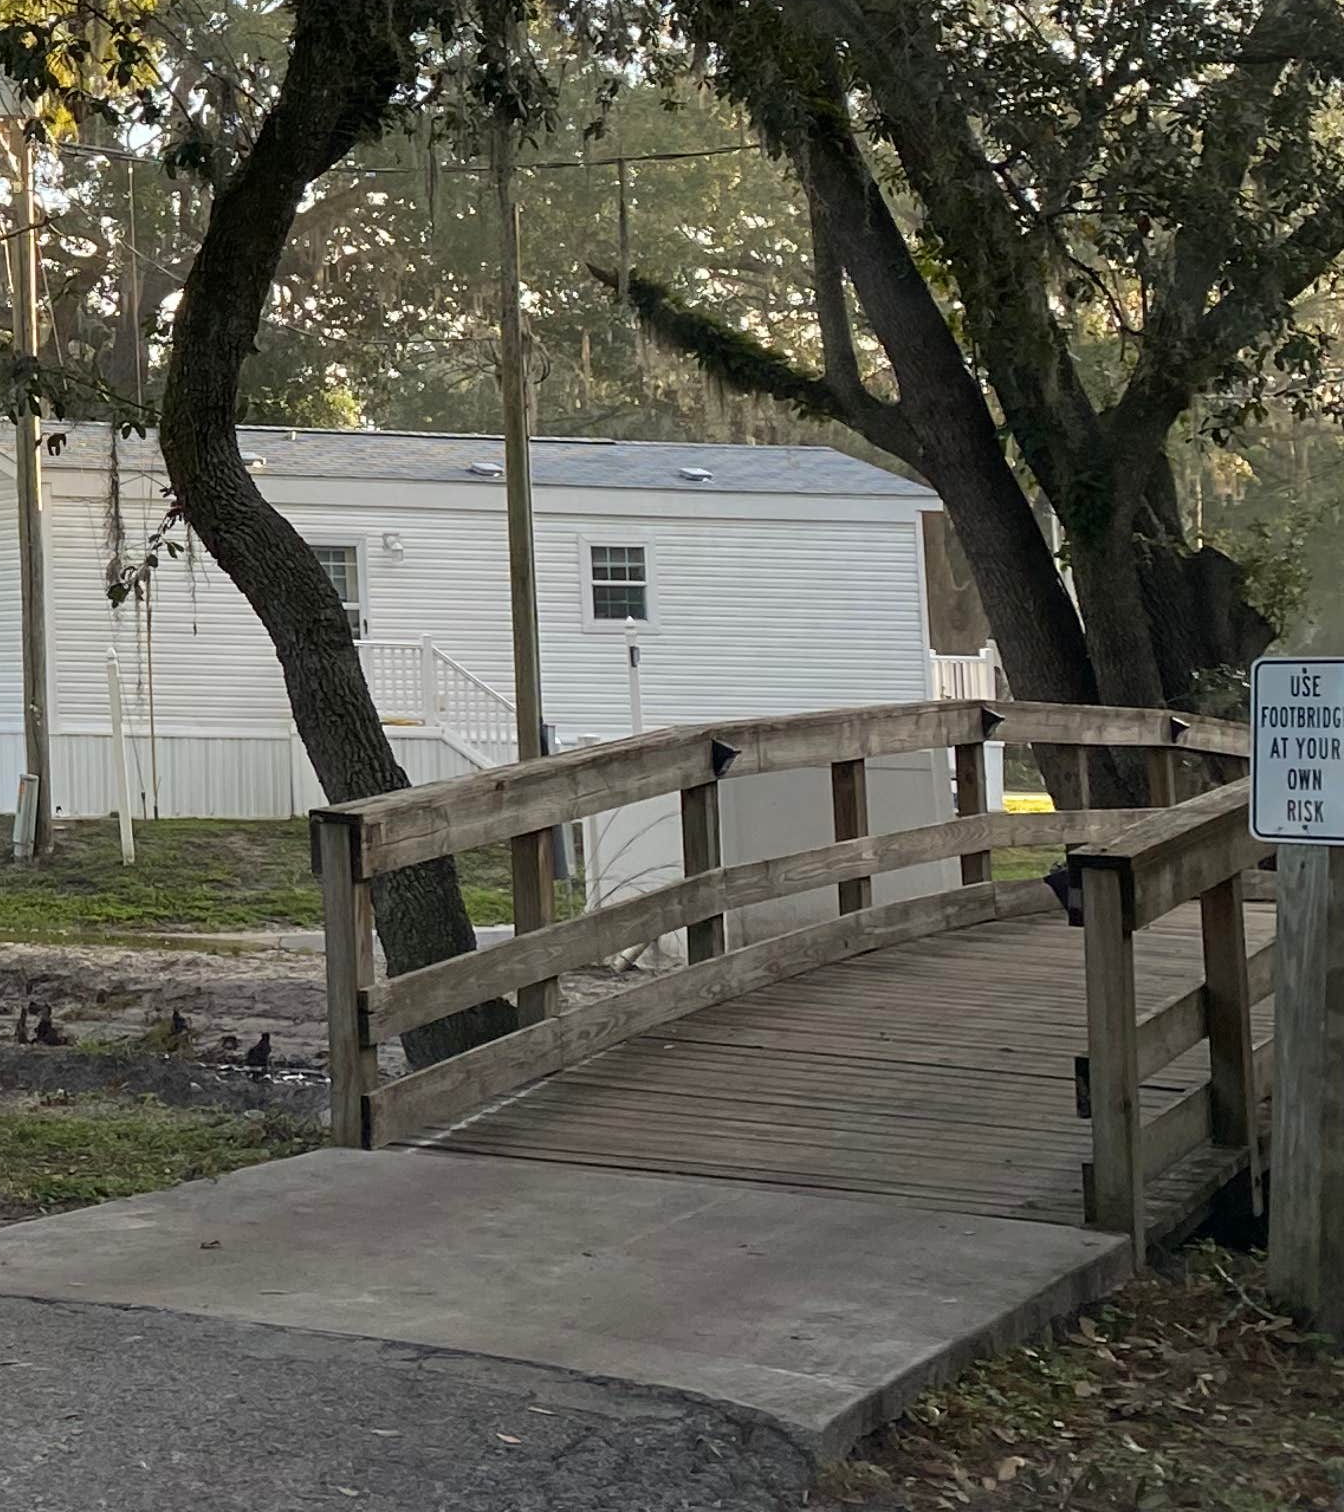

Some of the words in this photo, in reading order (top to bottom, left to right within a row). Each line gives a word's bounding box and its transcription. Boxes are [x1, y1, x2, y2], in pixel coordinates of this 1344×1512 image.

[1290, 675, 1321, 697] USE
[1261, 706, 1344, 728] FOOTBRIDG
[1270, 736, 1288, 759] AT
[1295, 736, 1341, 760] YOUR
[1287, 768, 1322, 791] OWN
[1287, 799, 1324, 823] RISK
